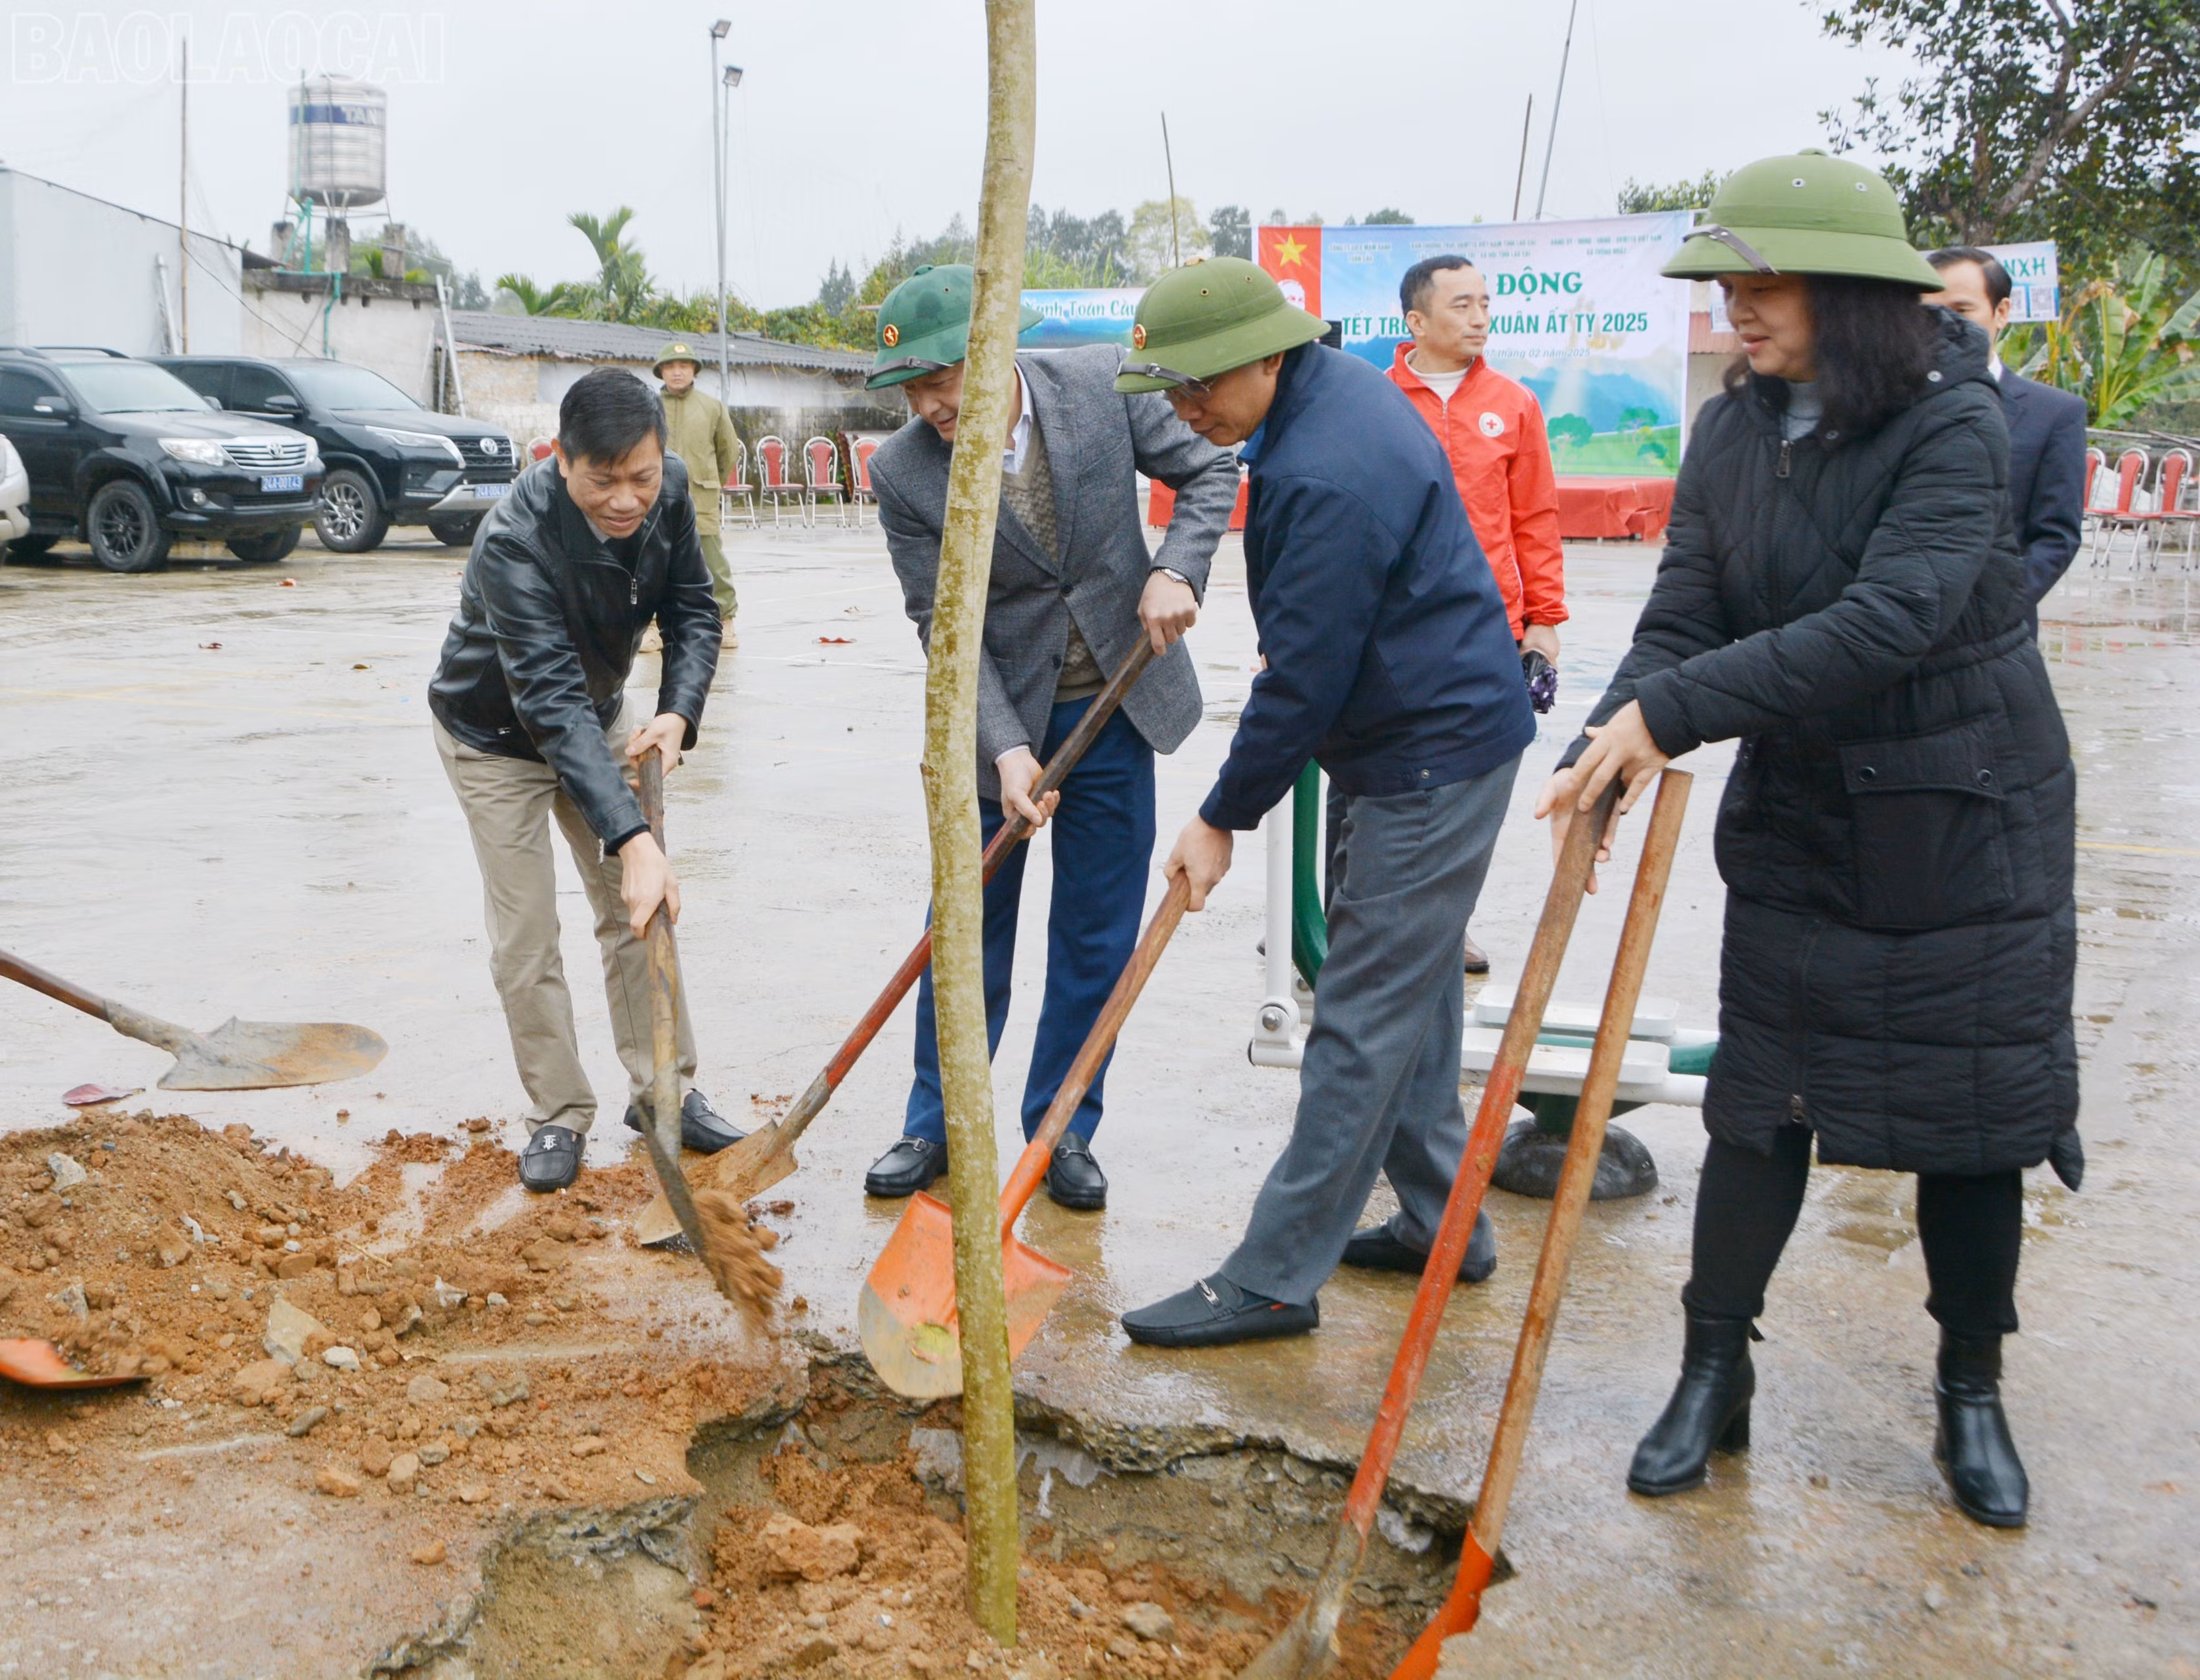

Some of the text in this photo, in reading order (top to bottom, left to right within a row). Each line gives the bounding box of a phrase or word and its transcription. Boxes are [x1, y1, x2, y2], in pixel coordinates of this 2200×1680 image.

[1496, 266, 1583, 301] ĐỘNG
[1342, 310, 1372, 335] TẾT
[1489, 310, 1539, 334] XUÂN
[1545, 306, 1568, 333] ẤT
[1602, 312, 1647, 333] 2025
[1529, 349, 1540, 357] 02
[1568, 347, 1590, 357] 2025
